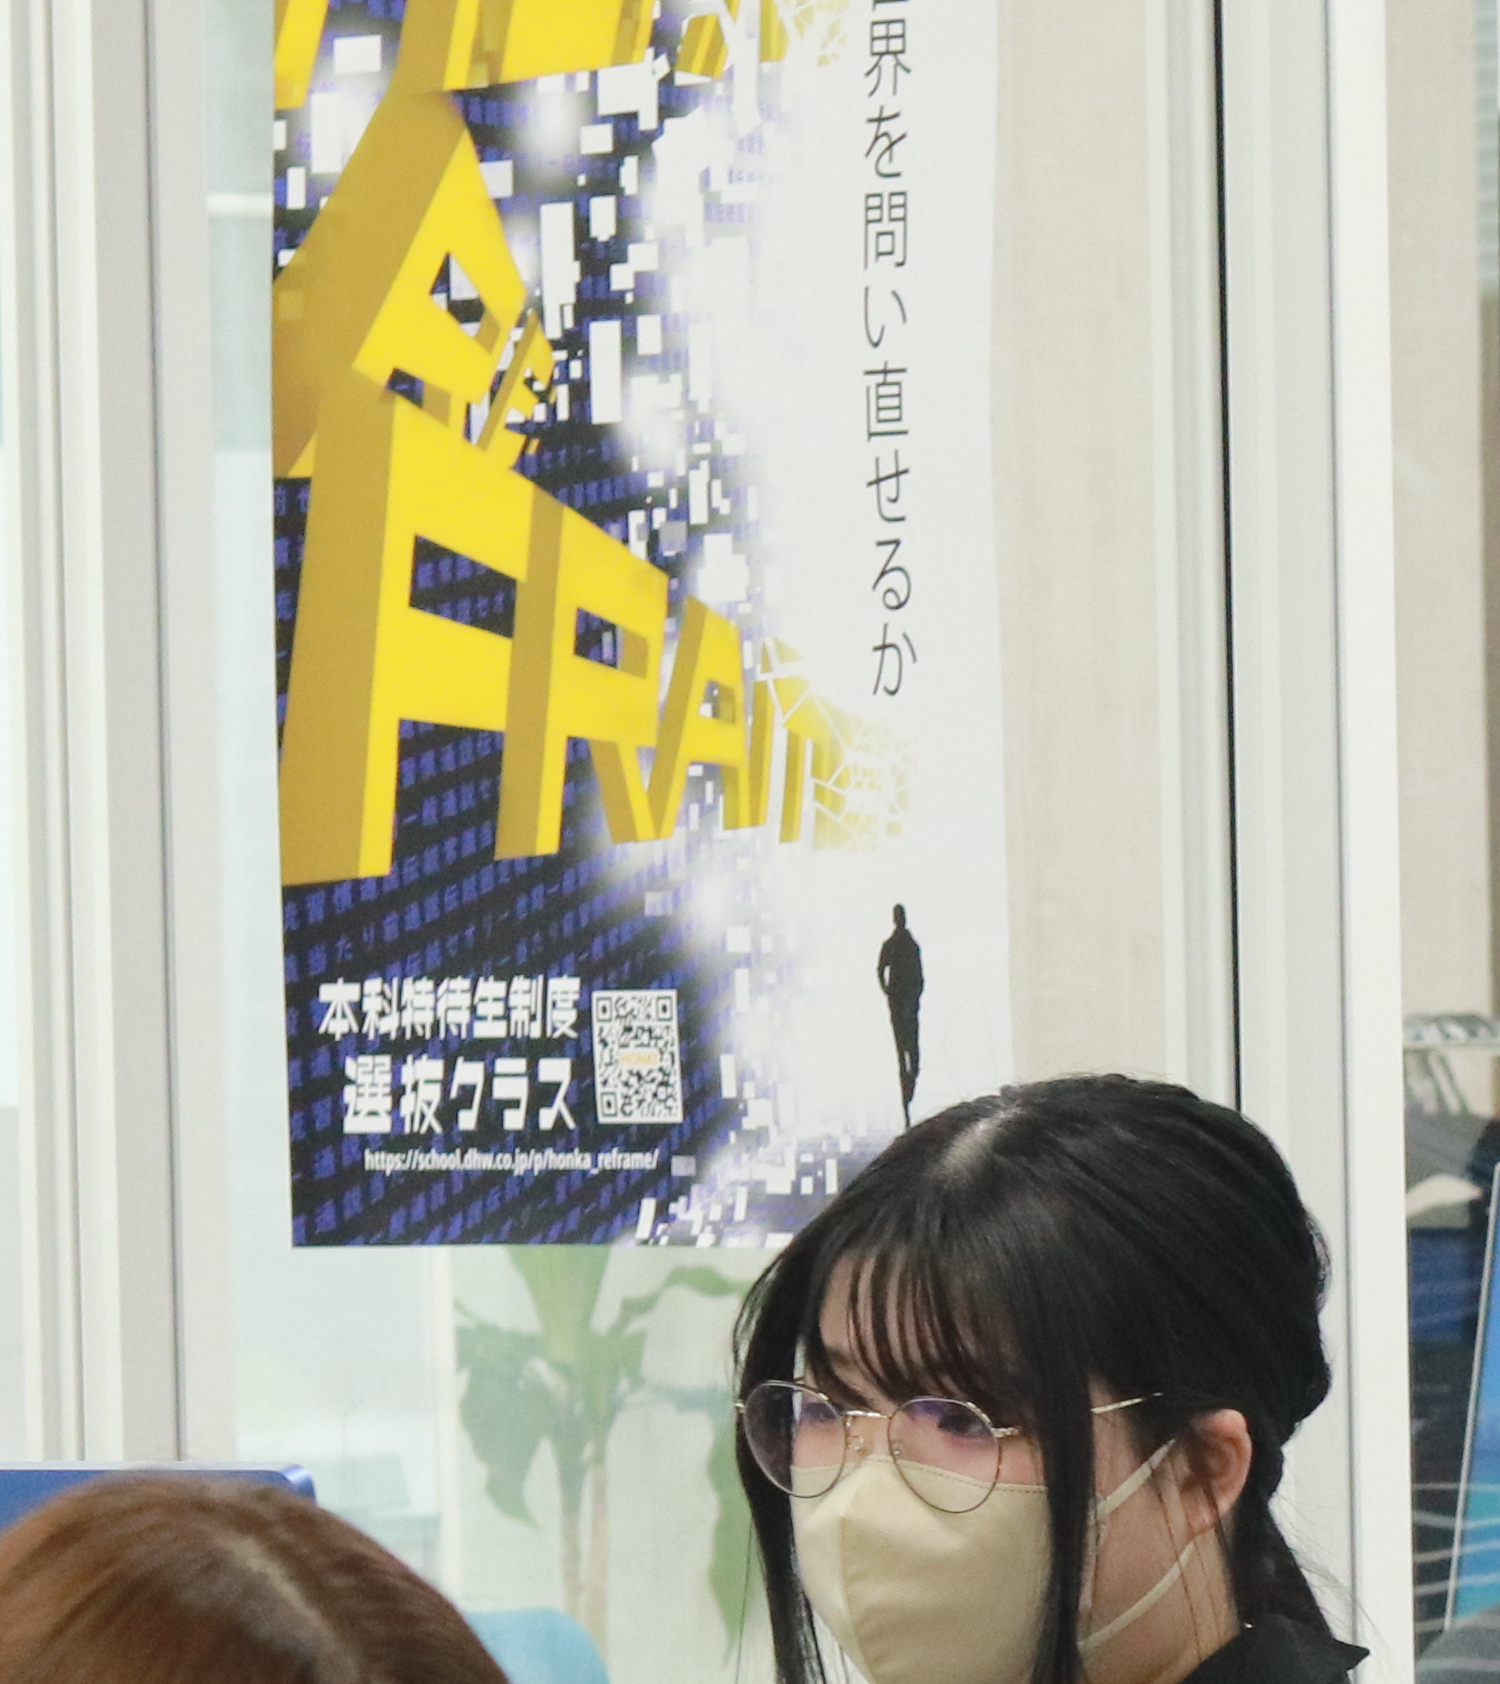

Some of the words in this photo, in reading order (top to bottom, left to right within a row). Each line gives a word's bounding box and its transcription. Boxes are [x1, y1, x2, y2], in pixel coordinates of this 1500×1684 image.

[863, 0, 918, 699] 界を問い直せるか
[318, 974, 582, 1042] 本科特待生制度
[342, 1053, 577, 1135] 選抜クラス
[363, 1147, 660, 1177] https://school.dhw.co.jp/p/honka_reframe/
